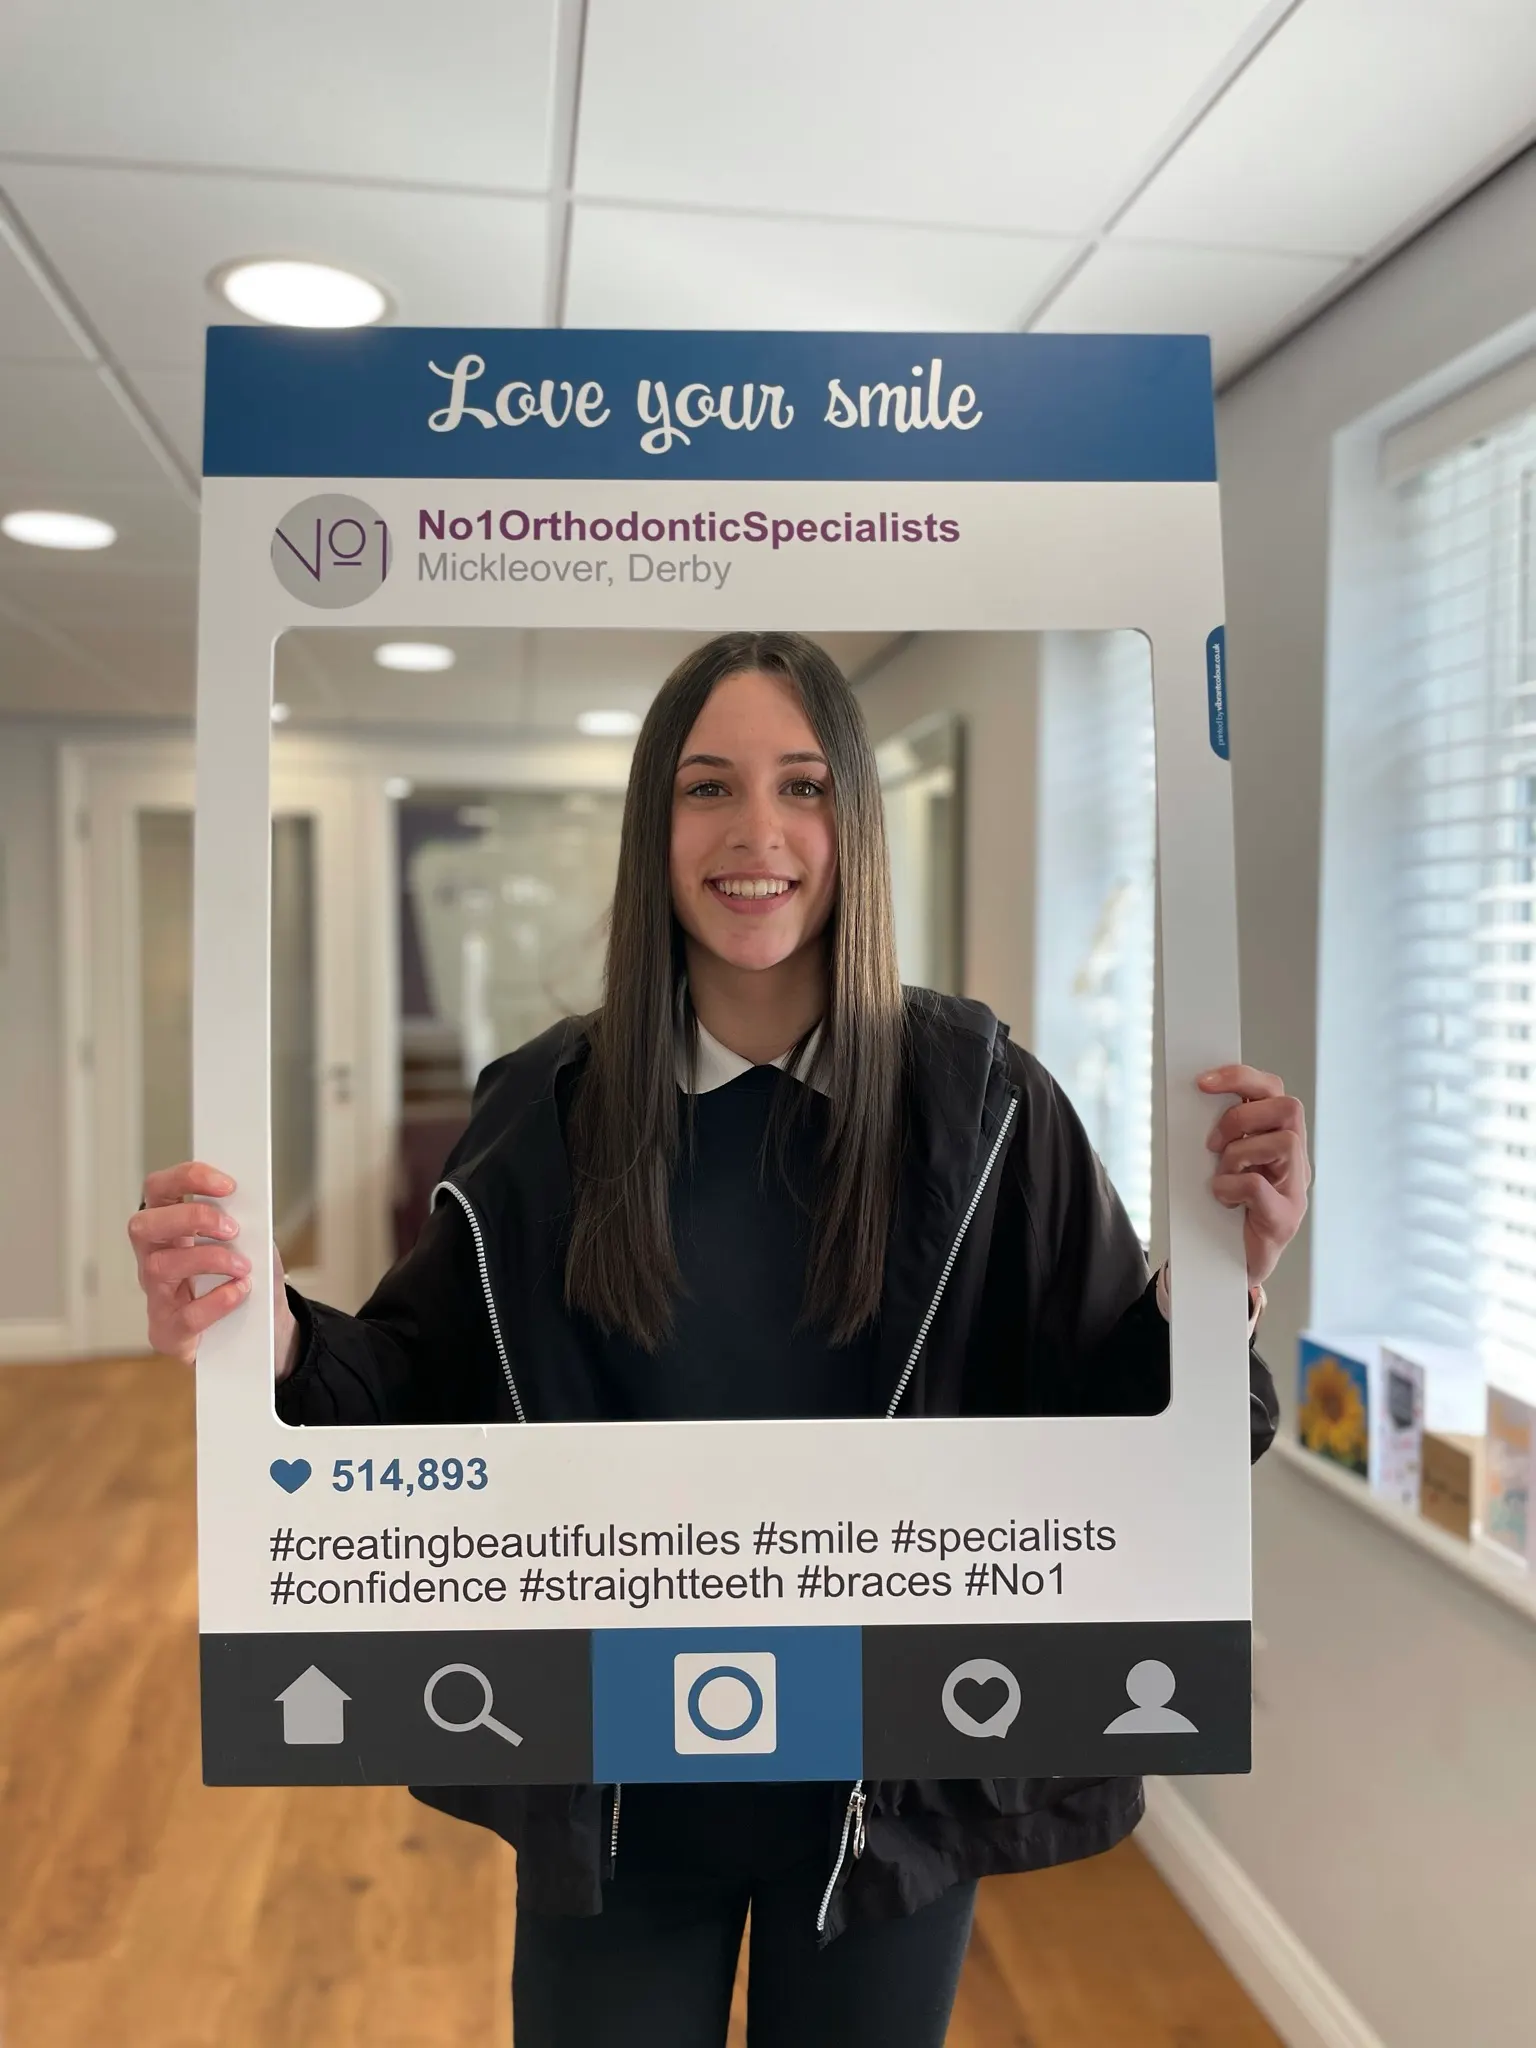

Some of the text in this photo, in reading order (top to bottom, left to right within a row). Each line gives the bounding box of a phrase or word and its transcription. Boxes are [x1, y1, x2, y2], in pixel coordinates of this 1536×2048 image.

[428, 355, 983, 454] Love your smile
[418, 508, 960, 548] No1OrthodonticSpecialists
[418, 553, 732, 590] Mickleover, Derby
[1212, 643, 1225, 746] printed by vibrantcolour.co.uk
[332, 1458, 489, 1497] 514,893
[270, 1519, 1117, 1568] #creatingbeautifulsmiles #smile #specialists
[270, 1562, 1063, 1609] #confidence #straightteeth #braces #No1
